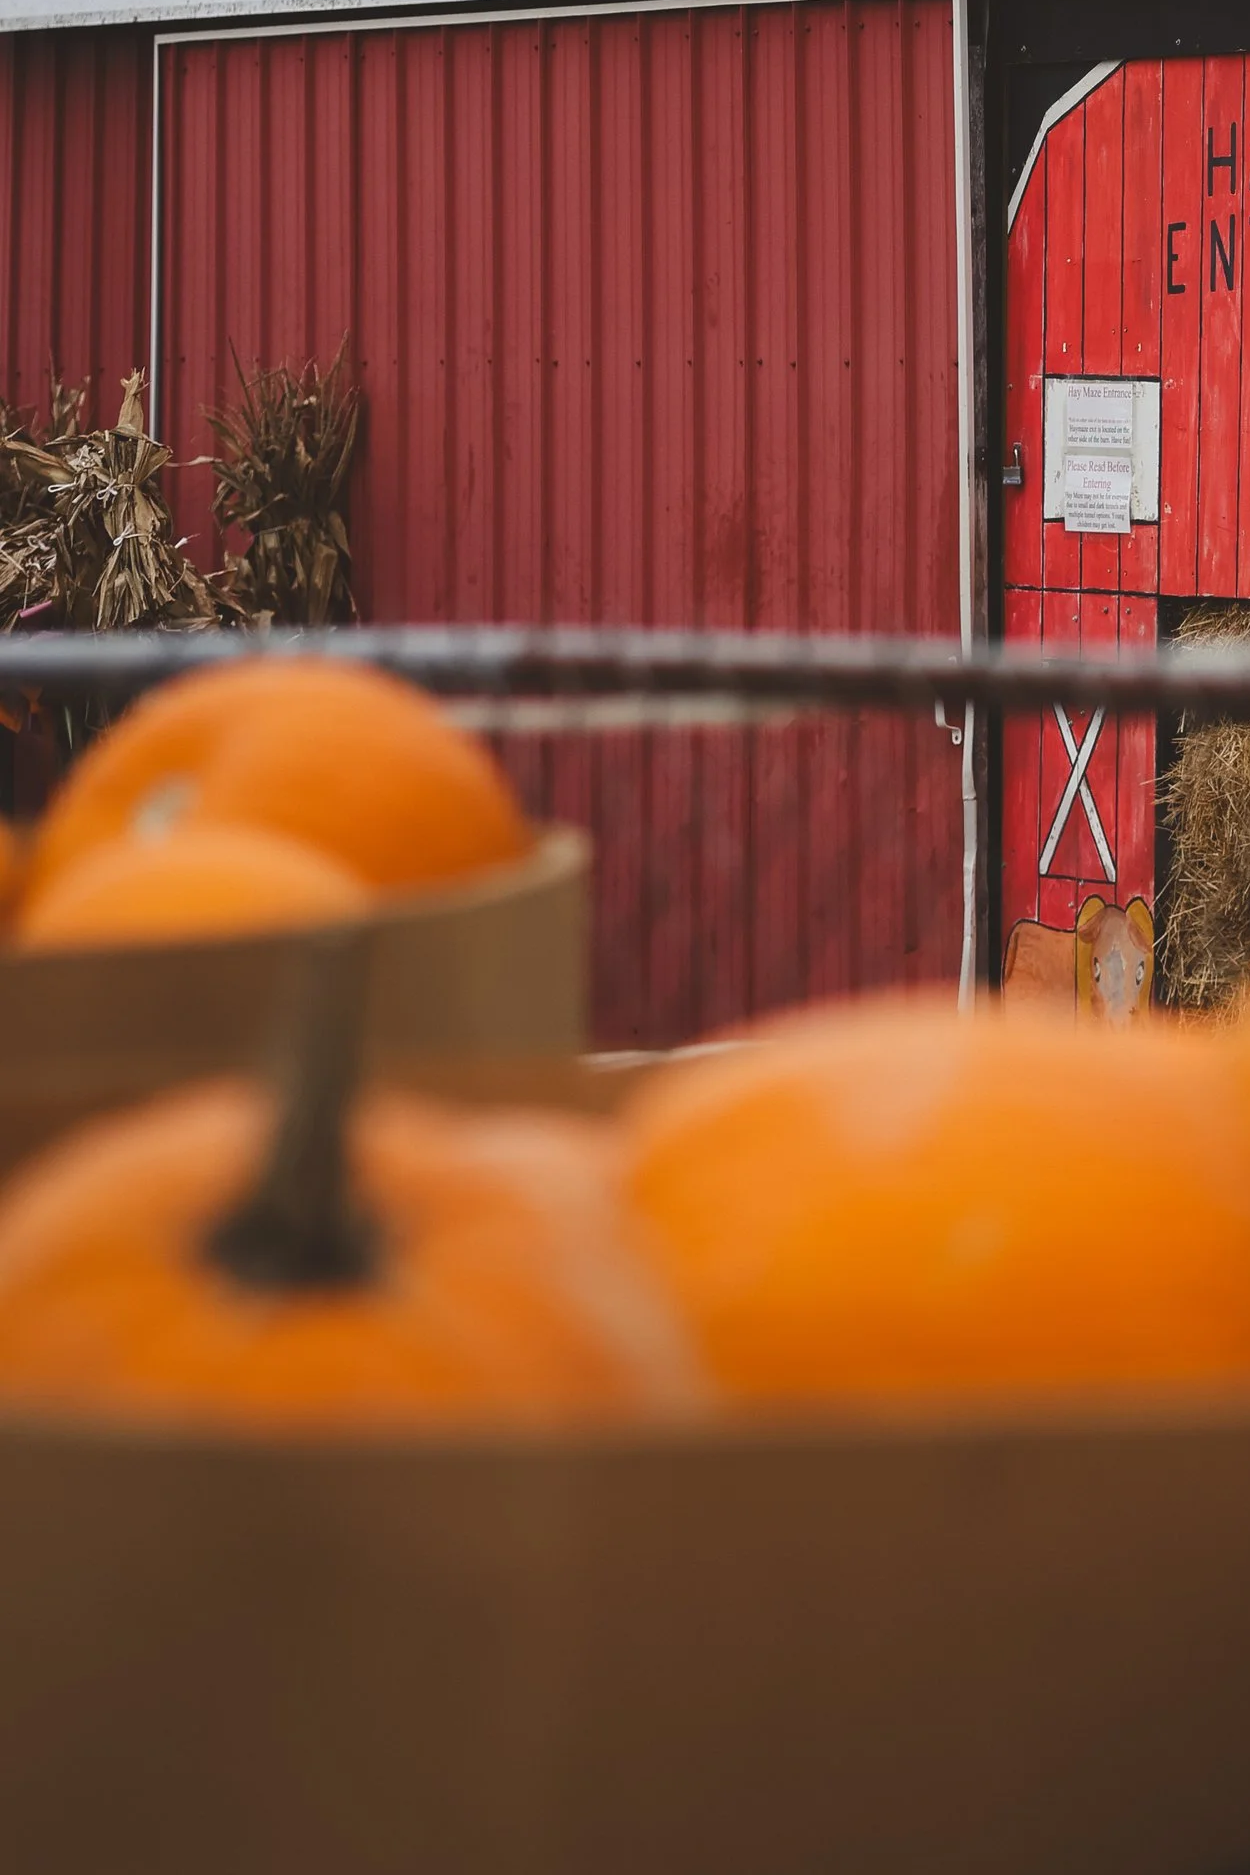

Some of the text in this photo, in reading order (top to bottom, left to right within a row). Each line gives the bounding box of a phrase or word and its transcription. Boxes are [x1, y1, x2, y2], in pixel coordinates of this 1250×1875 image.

[1068, 385, 1132, 400] Hay Maze Entrance
[1067, 460, 1130, 473] Please Read Before
[1082, 476, 1112, 492] Entering
